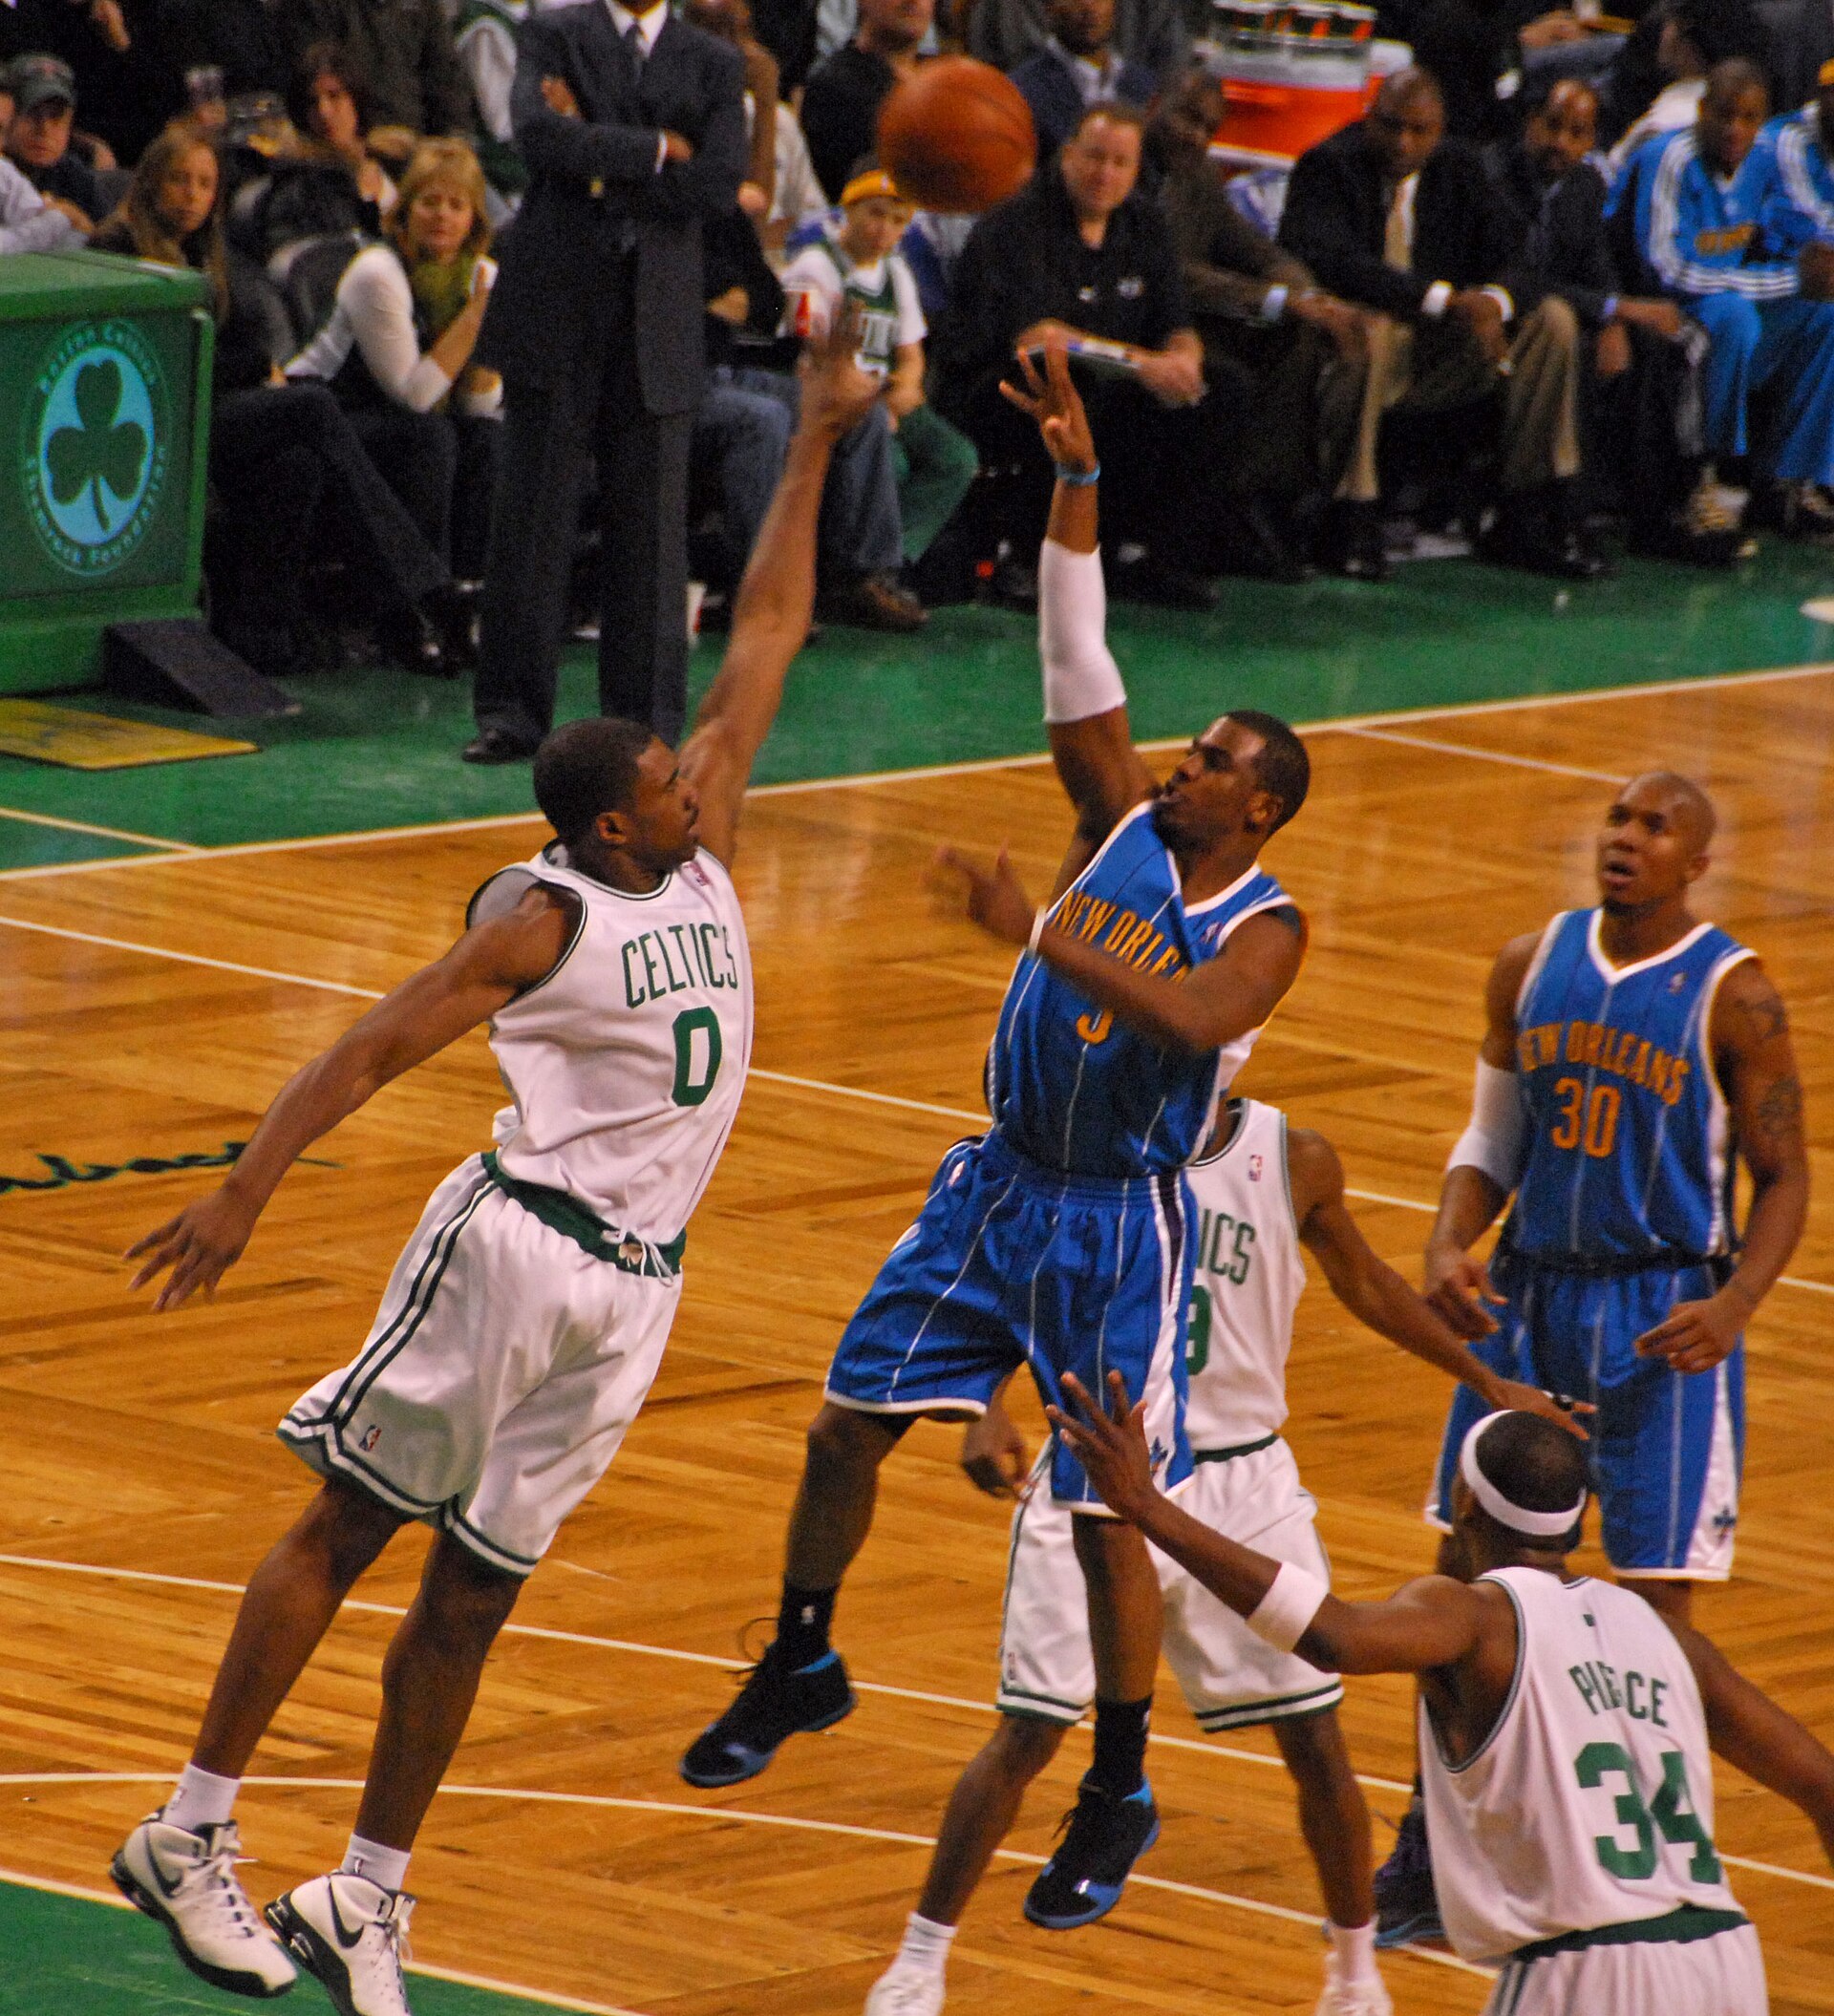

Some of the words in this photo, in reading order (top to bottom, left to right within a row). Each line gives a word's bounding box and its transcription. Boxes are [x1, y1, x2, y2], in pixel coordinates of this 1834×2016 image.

[621, 923, 737, 1009] CELTICS
[671, 1005, 723, 1108] 0
[1565, 1019, 1691, 1107] ORLEANS
[1550, 1076, 1622, 1158] 30
[1573, 1741, 1722, 1885] 34
